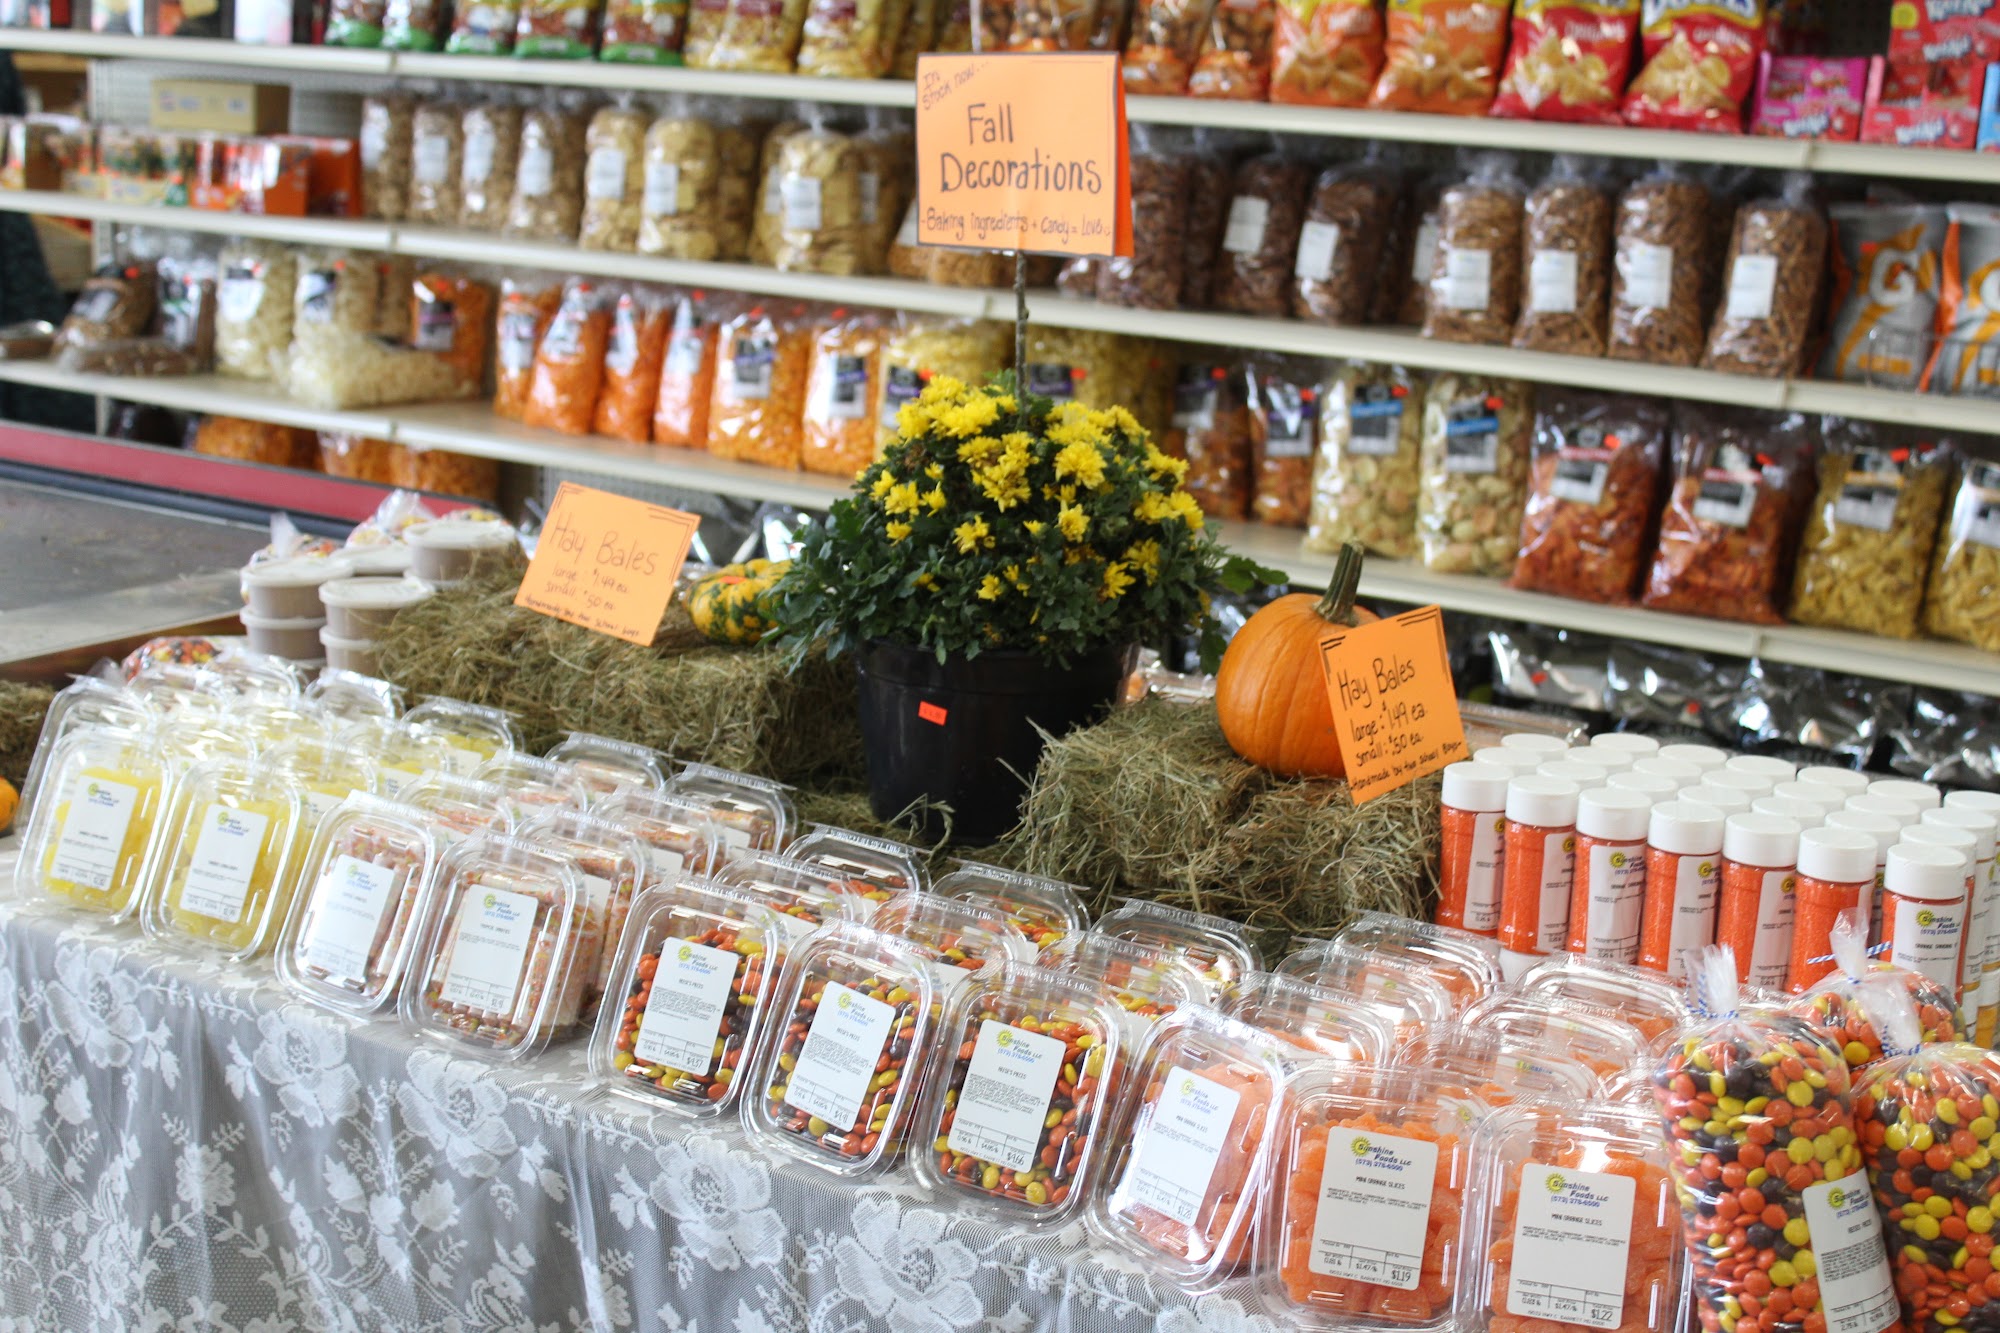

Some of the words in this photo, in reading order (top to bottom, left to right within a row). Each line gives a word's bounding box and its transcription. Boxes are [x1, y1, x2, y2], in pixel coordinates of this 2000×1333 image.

[968, 103, 1014, 145] Fall
[940, 147, 1102, 194] Decorations
[550, 512, 585, 565] Hay
[596, 530, 658, 576] Bales
[1337, 668, 1372, 711] Hay
[1372, 654, 1416, 695] Bales
[1012, 1045, 1032, 1055] Foods
[1357, 1142, 1393, 1155] Sunshine
[1374, 1154, 1397, 1162] Foods
[1552, 1179, 1590, 1191] Sunshine
[1570, 1190, 1594, 1199] Foods
